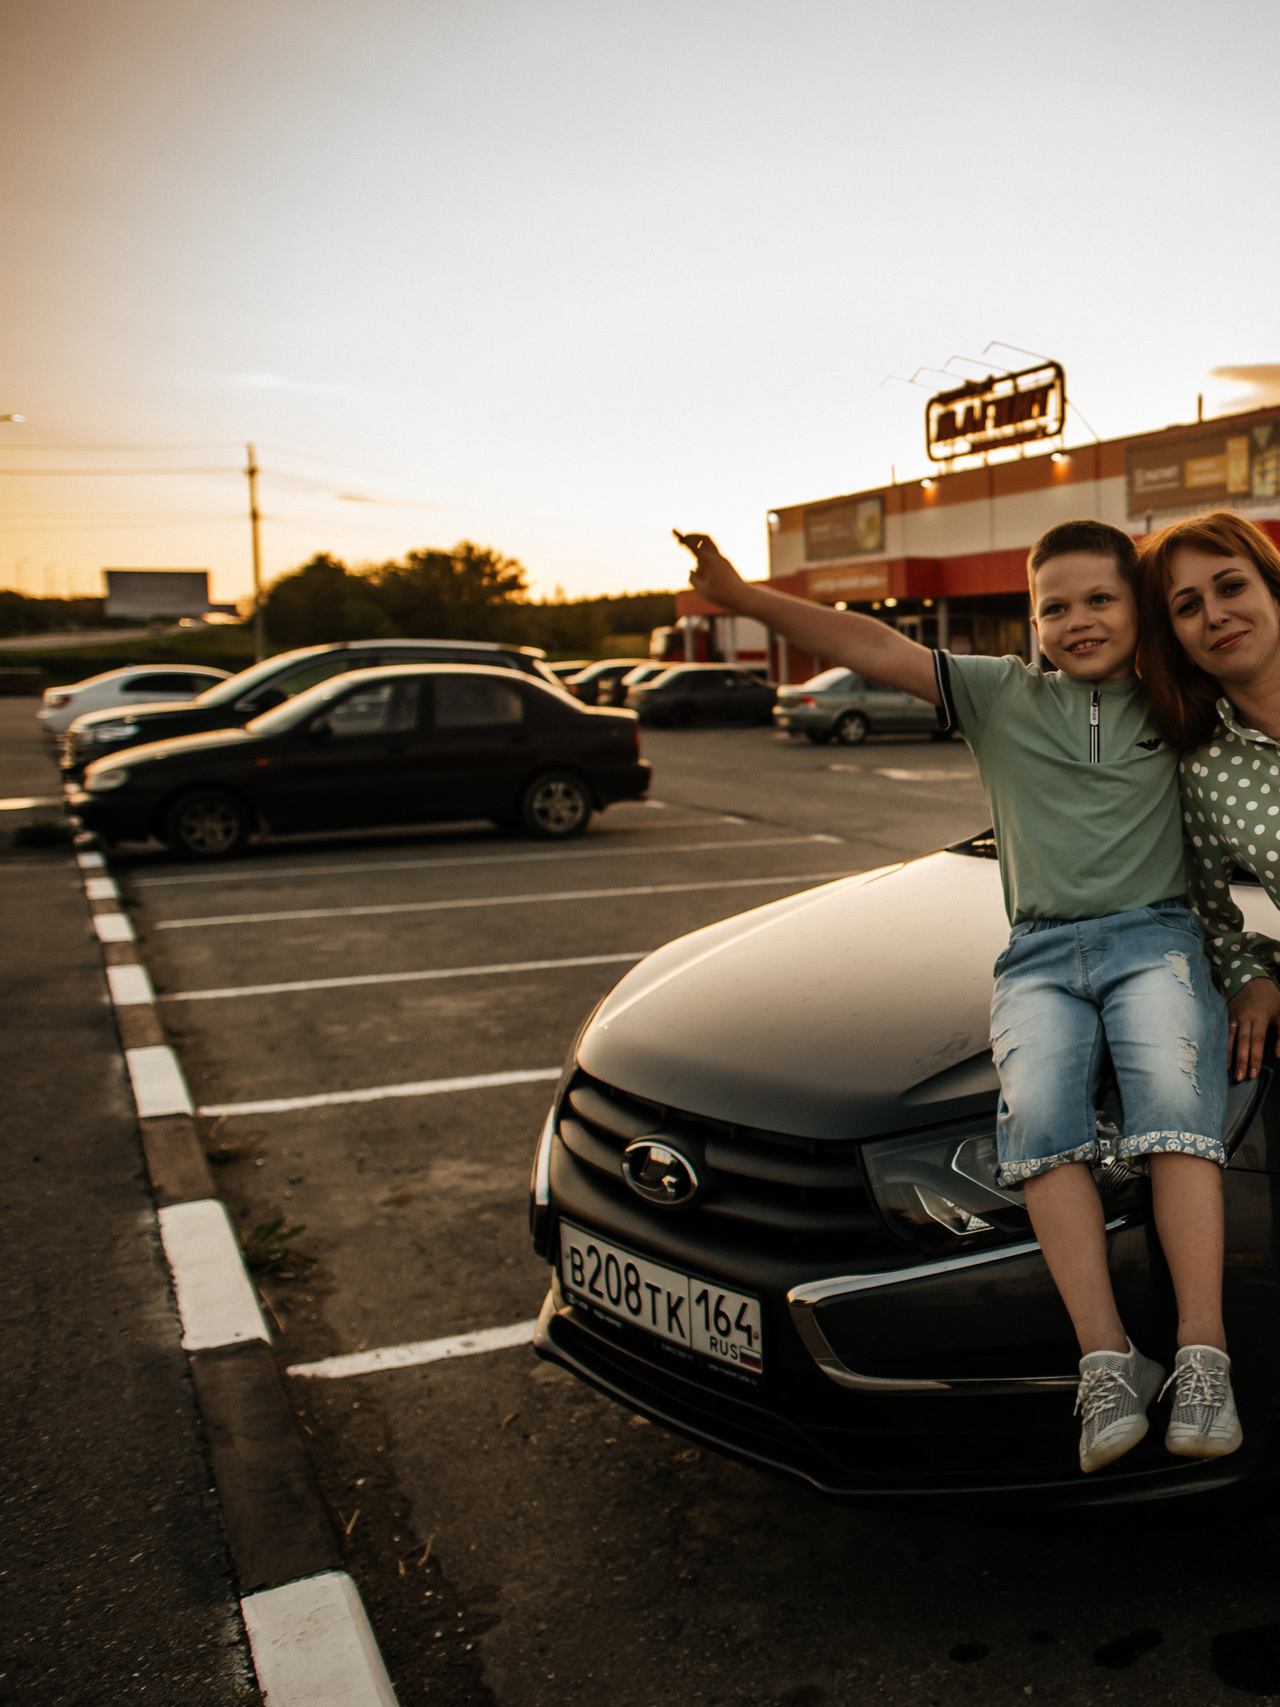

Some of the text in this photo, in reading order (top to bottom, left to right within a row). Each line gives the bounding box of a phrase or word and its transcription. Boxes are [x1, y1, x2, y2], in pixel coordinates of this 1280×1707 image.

[570, 1245, 752, 1346] В208ТК 164
[710, 1336, 738, 1360] RUS
